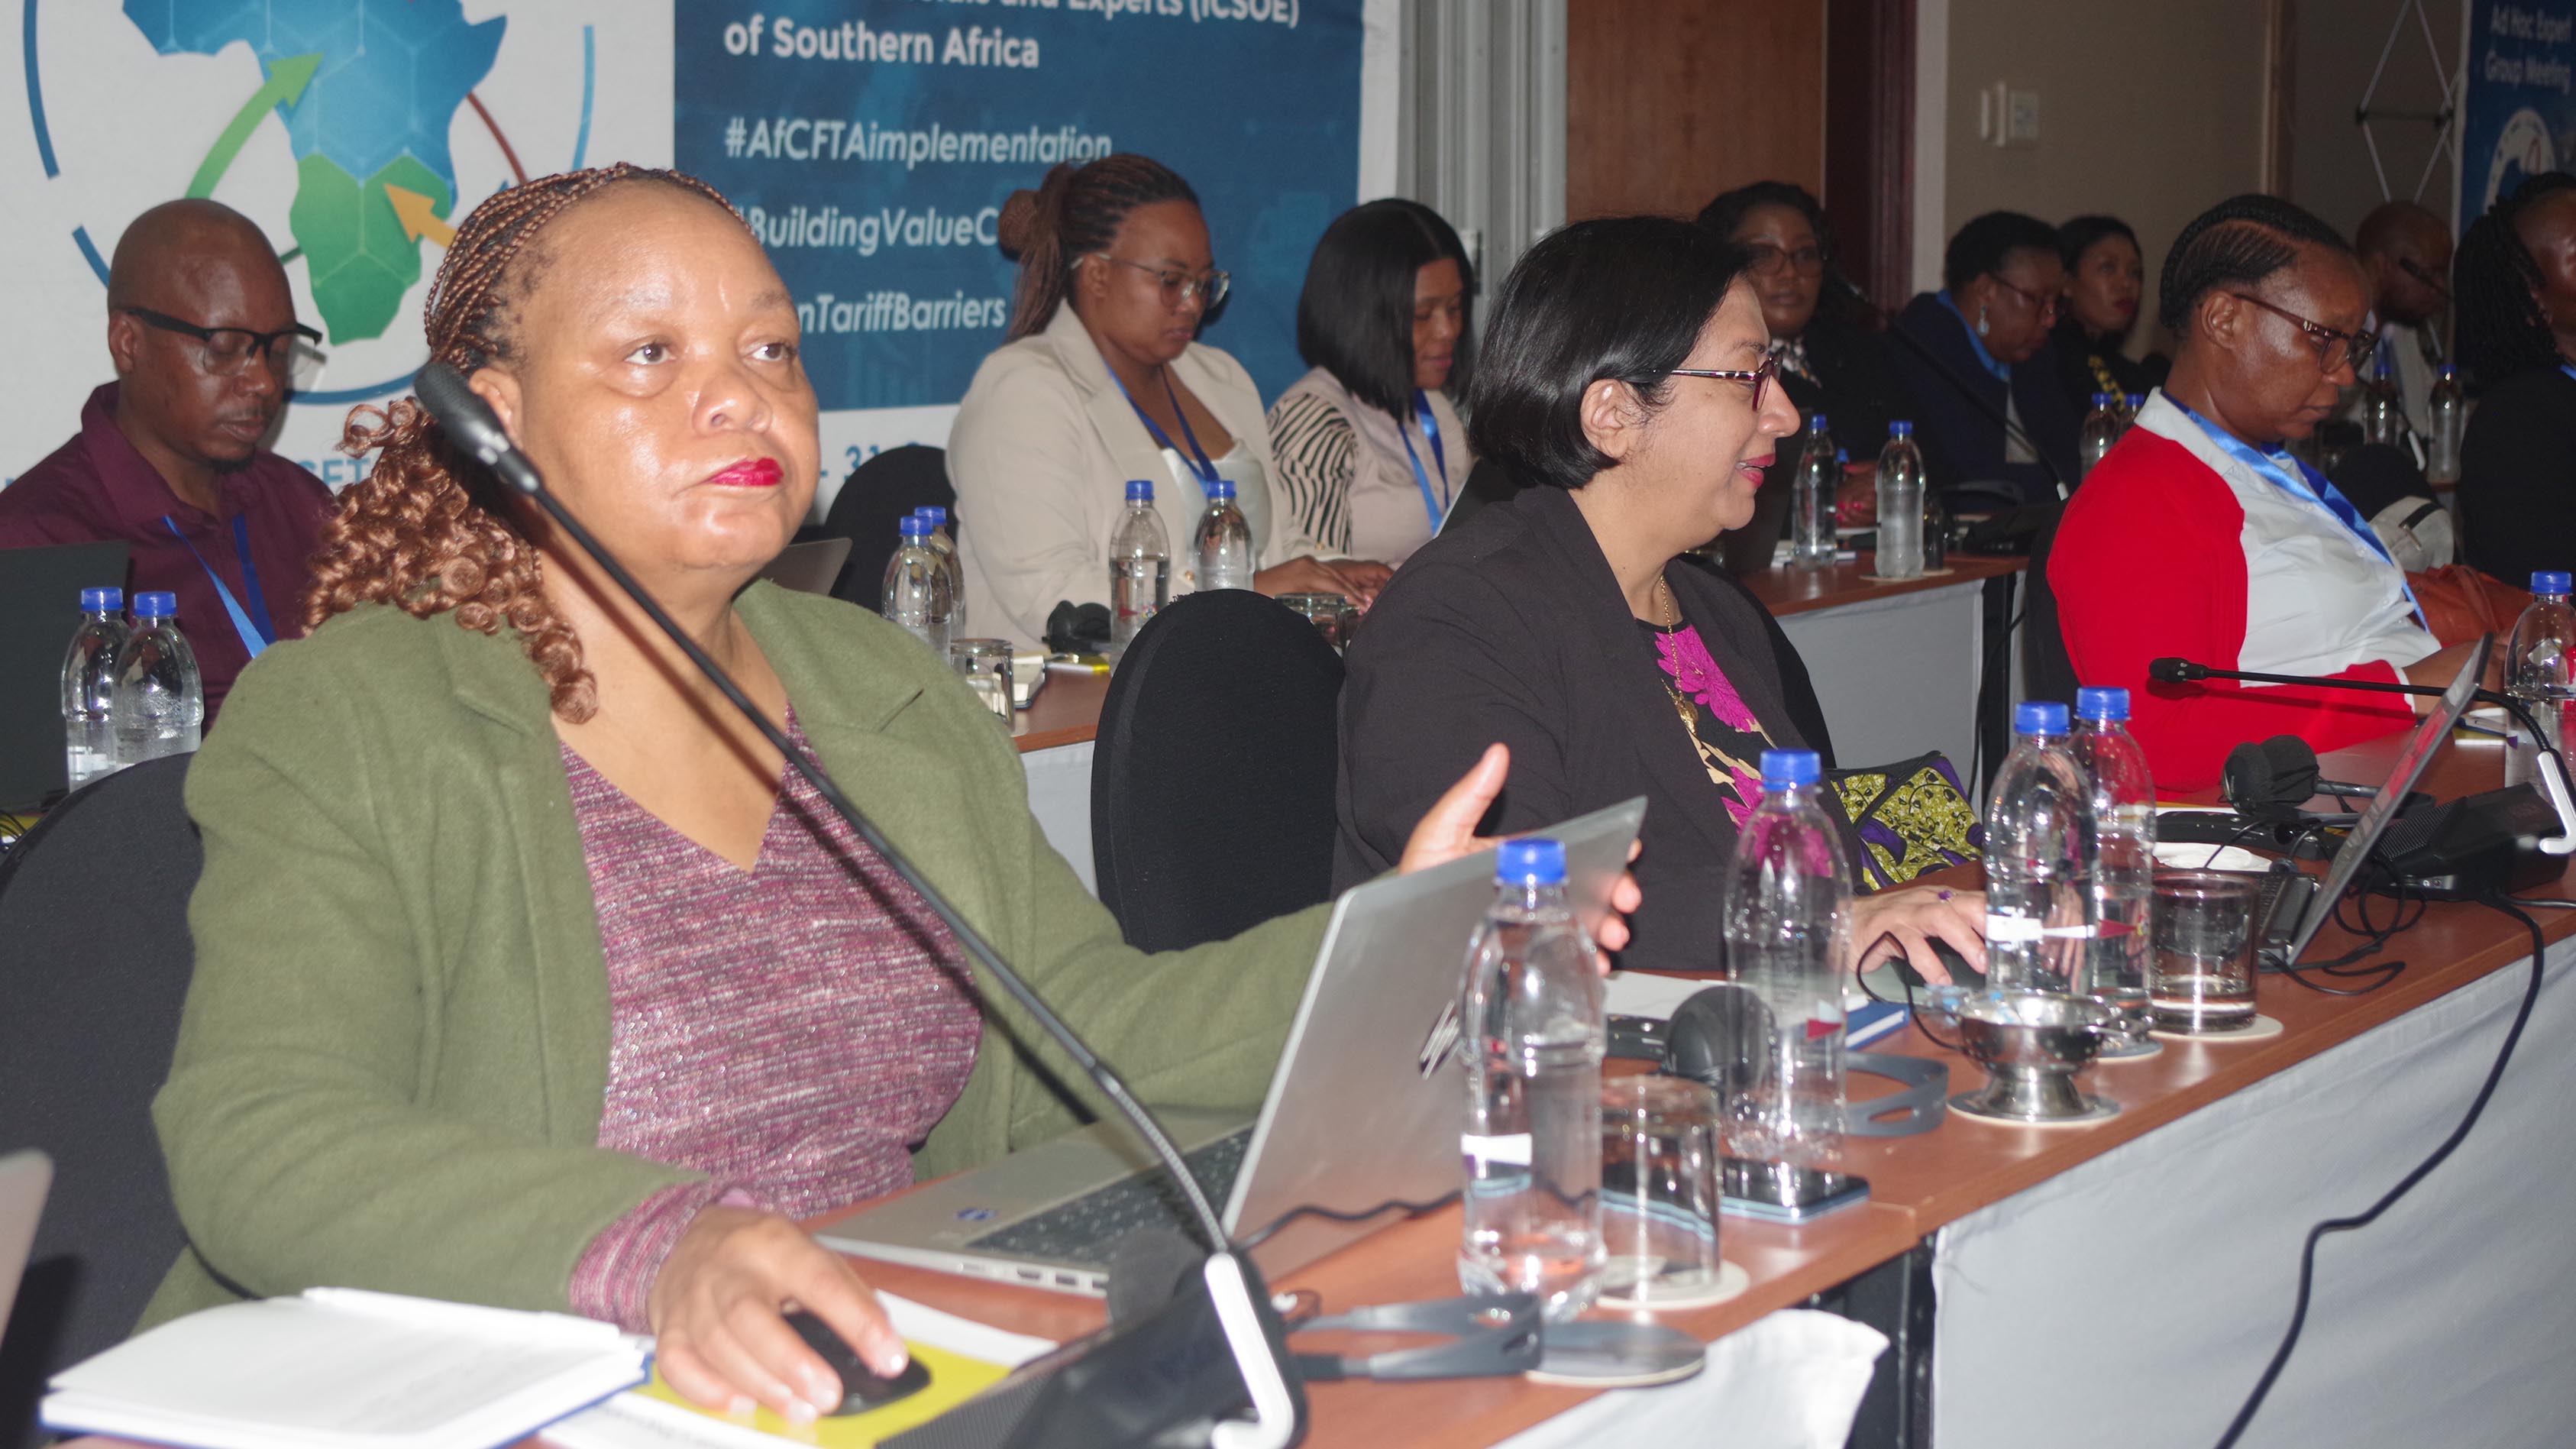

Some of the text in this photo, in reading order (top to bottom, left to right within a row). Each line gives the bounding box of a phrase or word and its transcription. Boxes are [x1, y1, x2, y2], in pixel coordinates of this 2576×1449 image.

[724, 13, 1040, 69] of Southern Africa
[725, 118, 1113, 170] #AfCFTAimplementation
